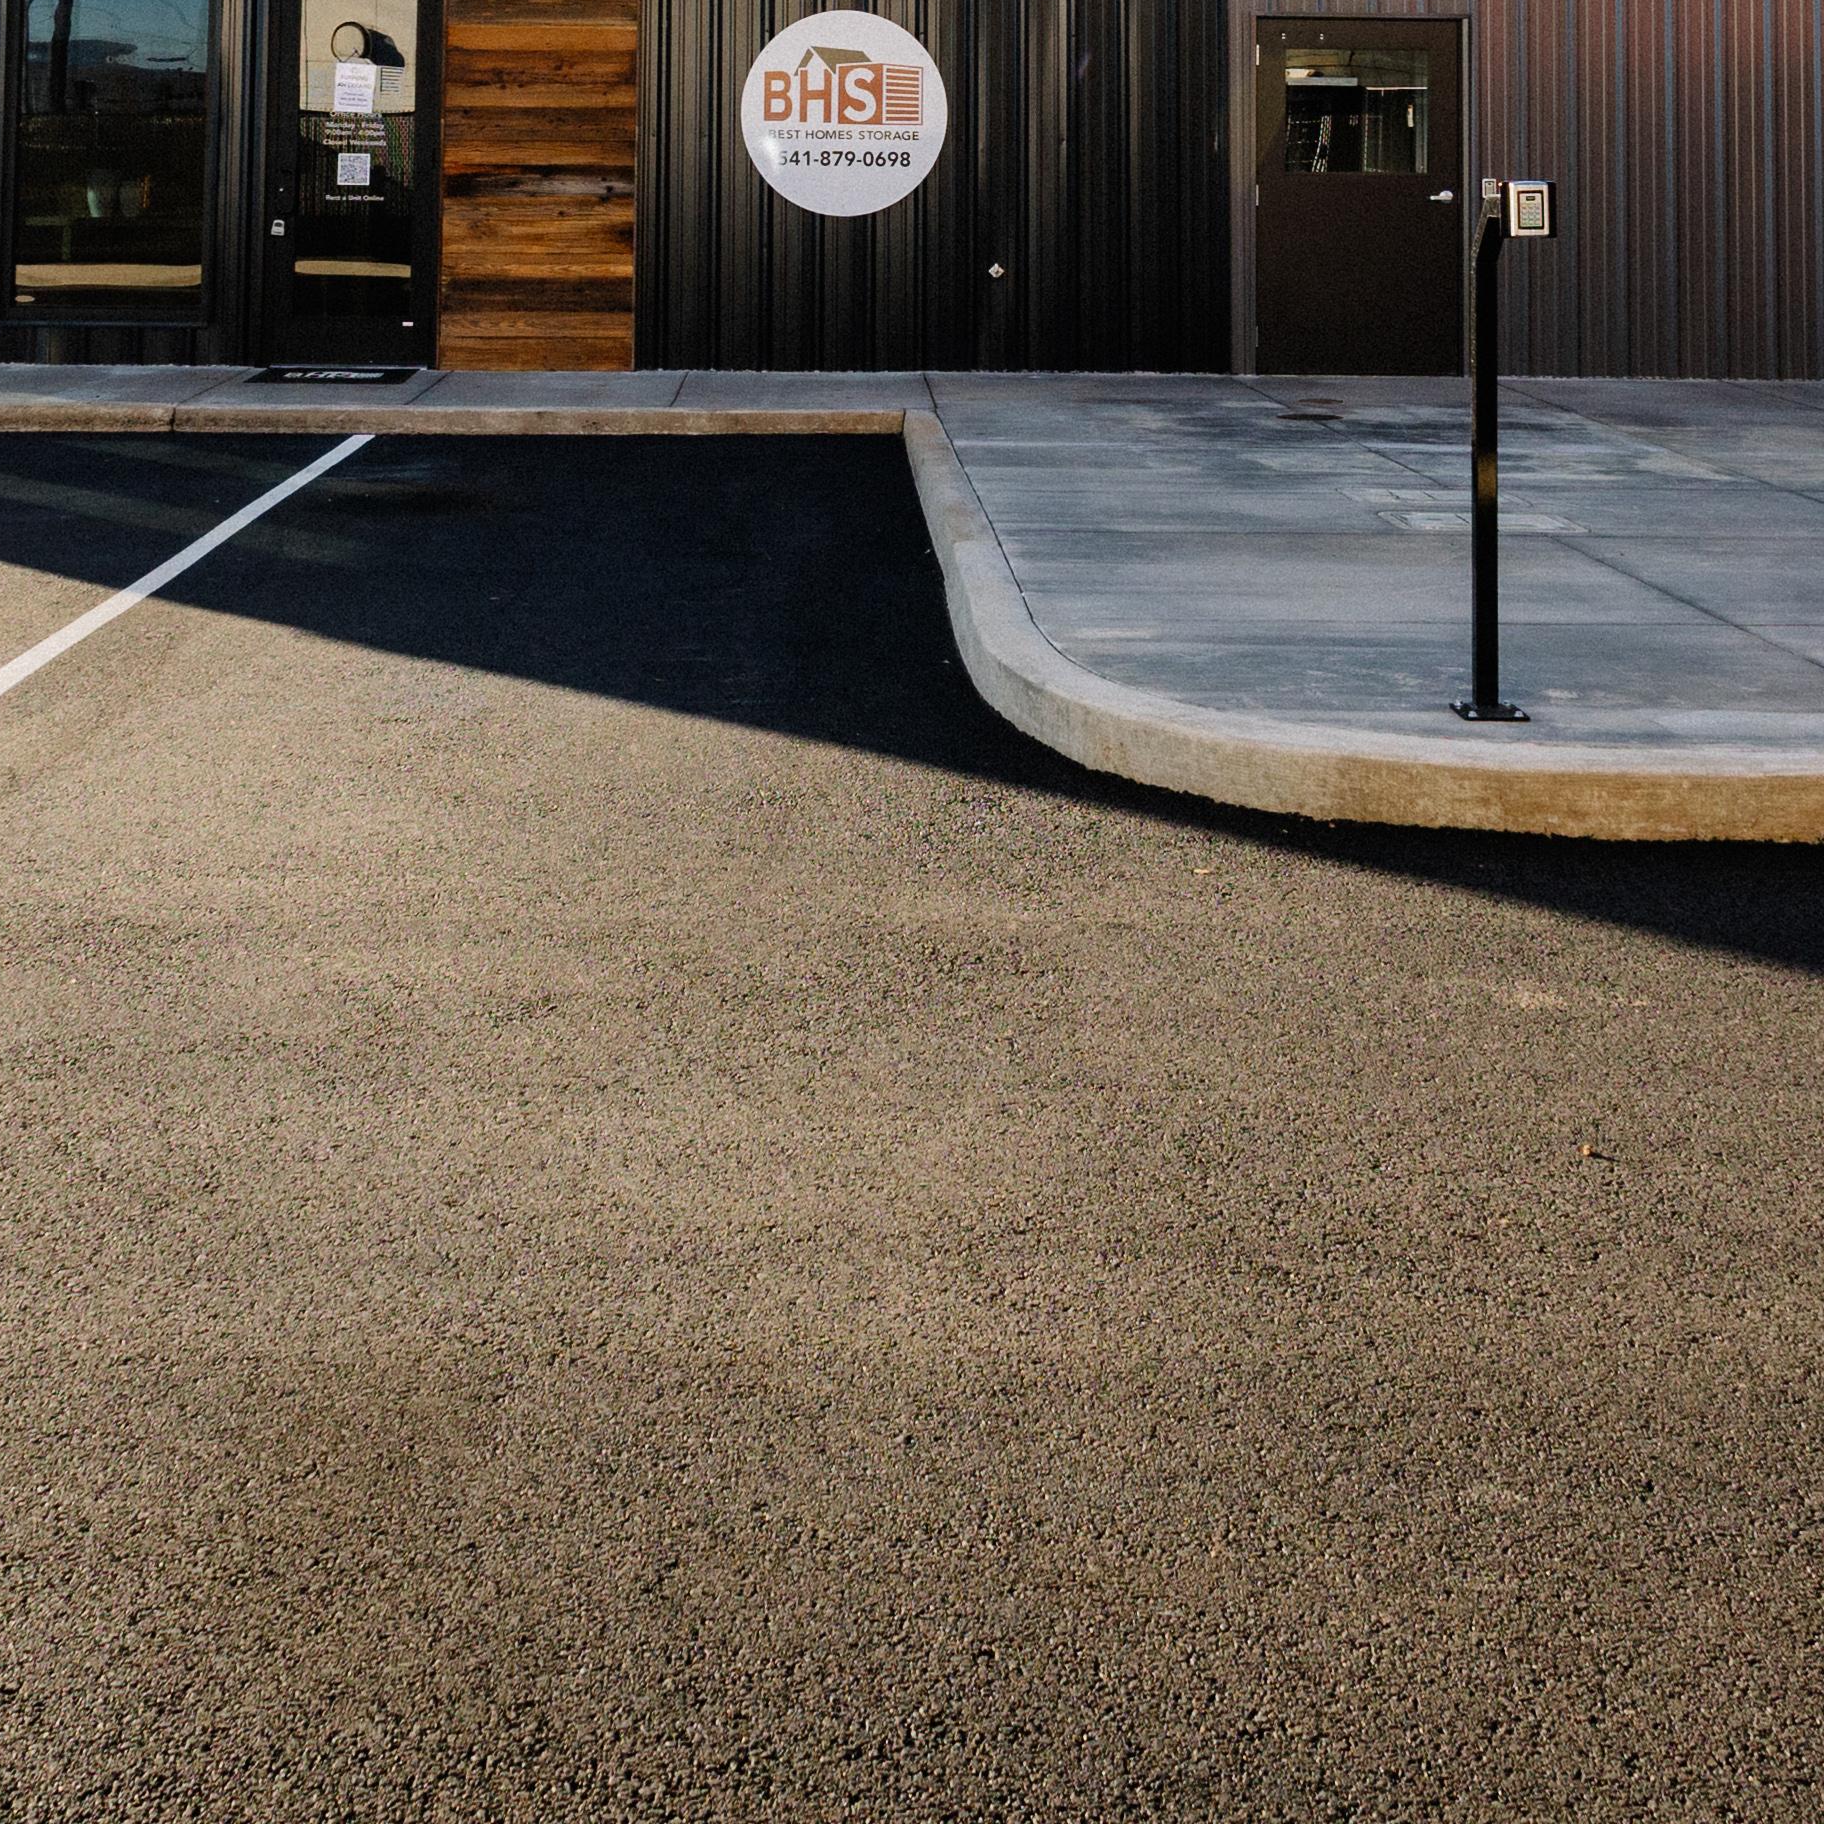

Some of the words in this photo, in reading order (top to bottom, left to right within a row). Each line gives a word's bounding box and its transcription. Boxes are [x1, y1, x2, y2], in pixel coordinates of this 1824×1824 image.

[763, 66, 877, 123] BHS
[768, 129, 801, 140] BEST
[805, 129, 853, 141] HOMES
[858, 130, 920, 141] STORAGE
[778, 150, 911, 167] 541-879-0698
